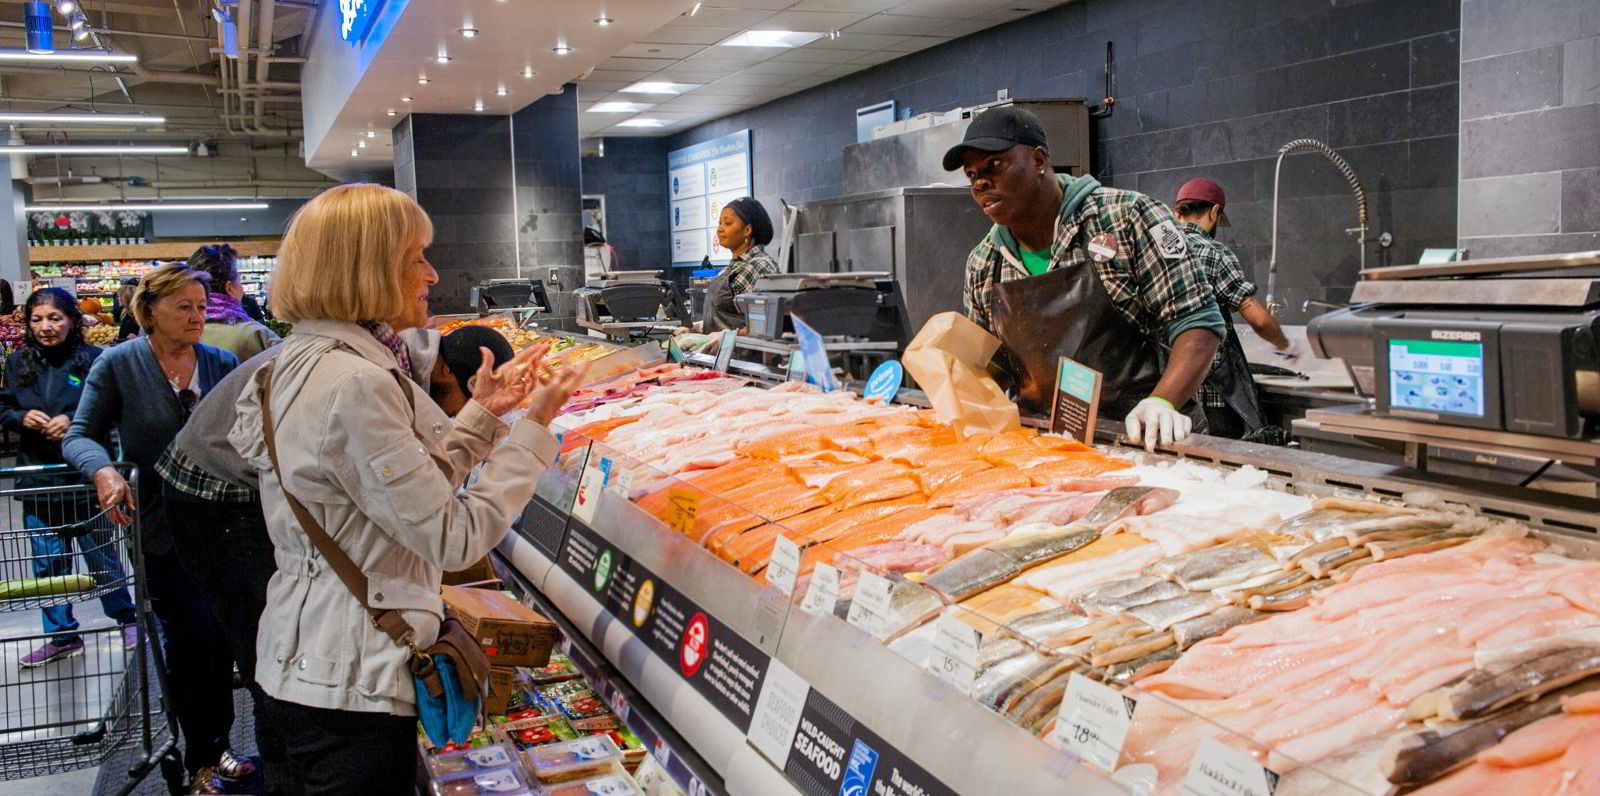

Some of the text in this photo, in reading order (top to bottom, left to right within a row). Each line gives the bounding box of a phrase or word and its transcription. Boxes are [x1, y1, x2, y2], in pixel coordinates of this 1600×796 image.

[1431, 330, 1481, 341] BIZERBA
[766, 690, 796, 726] SEAFOOD
[794, 733, 841, 780] SEAFOOD
[801, 717, 845, 761] WILD-CAUGHT
[1199, 761, 1238, 789] Haddock
